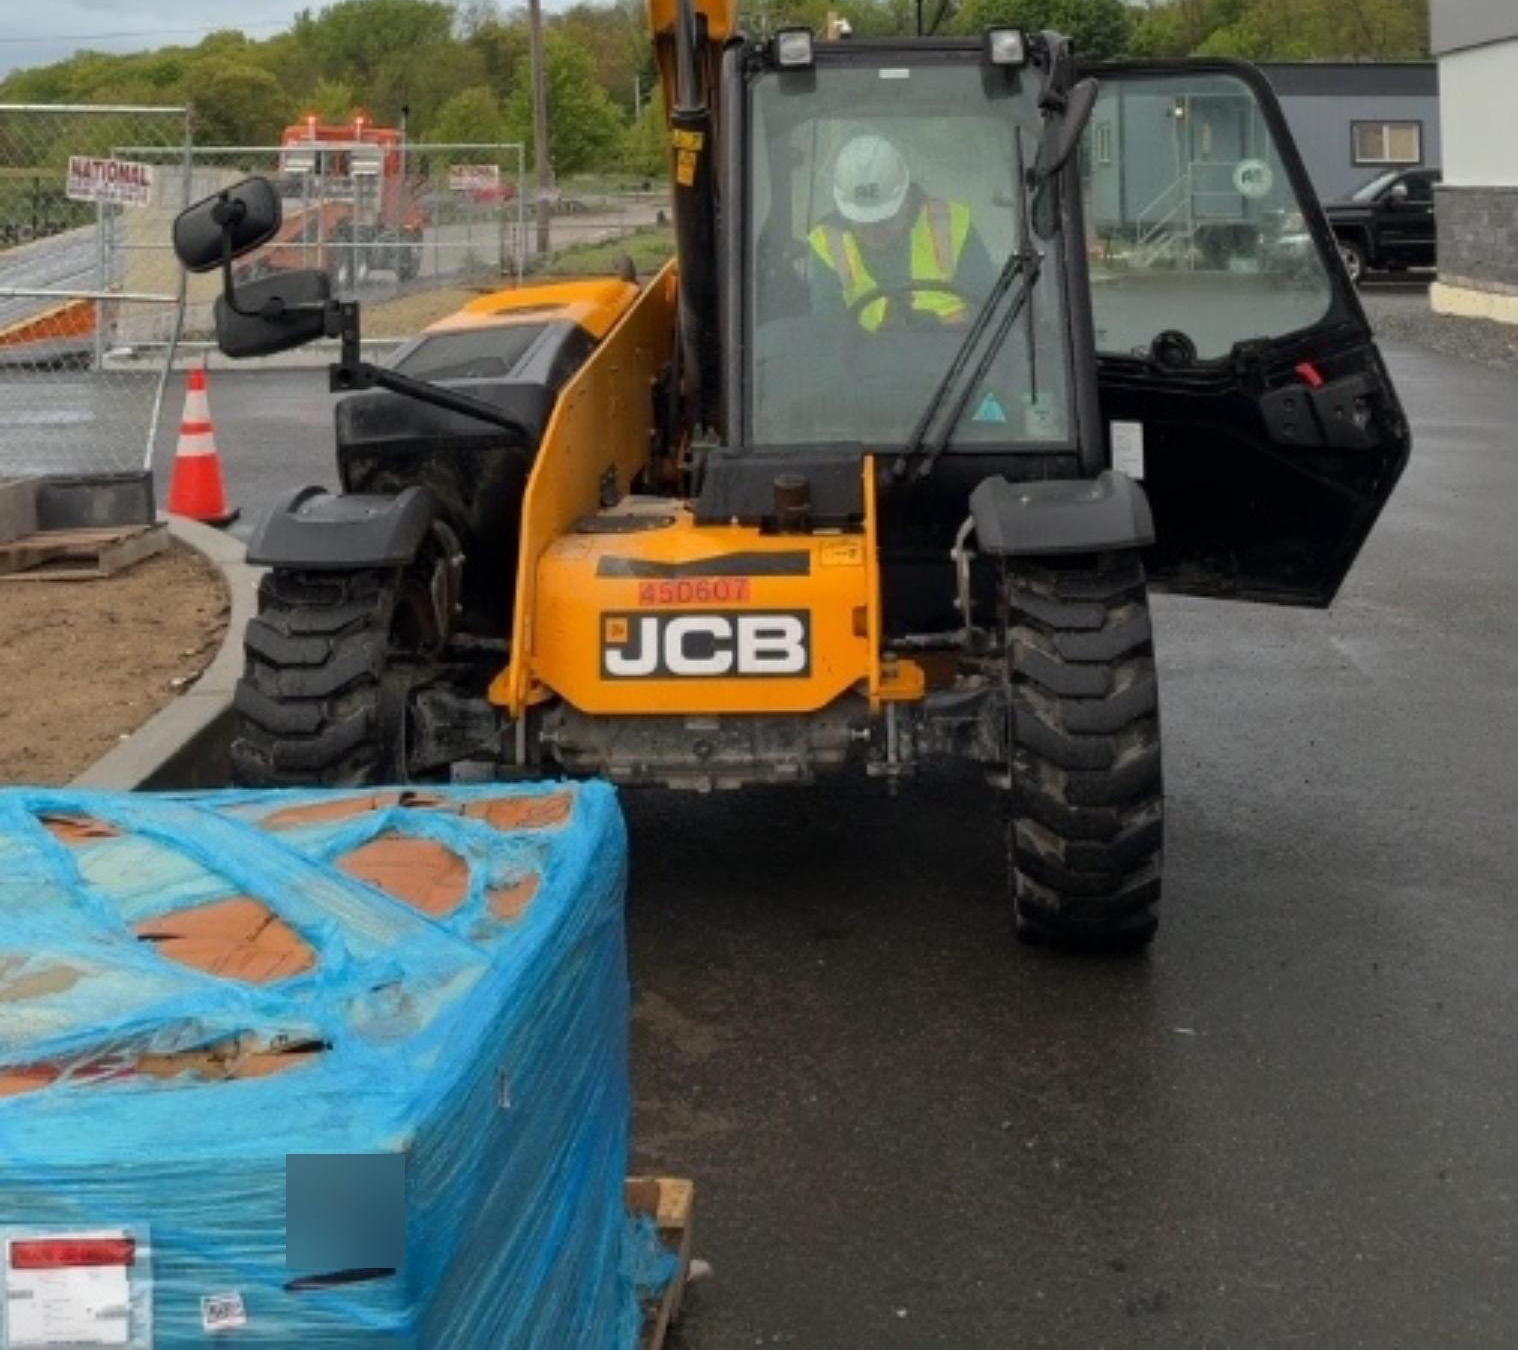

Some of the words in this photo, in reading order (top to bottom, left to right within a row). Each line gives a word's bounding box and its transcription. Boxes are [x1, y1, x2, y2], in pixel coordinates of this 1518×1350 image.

[72, 160, 150, 186] NATIONAL
[639, 578, 748, 604] 450607
[605, 614, 806, 676] JCB
